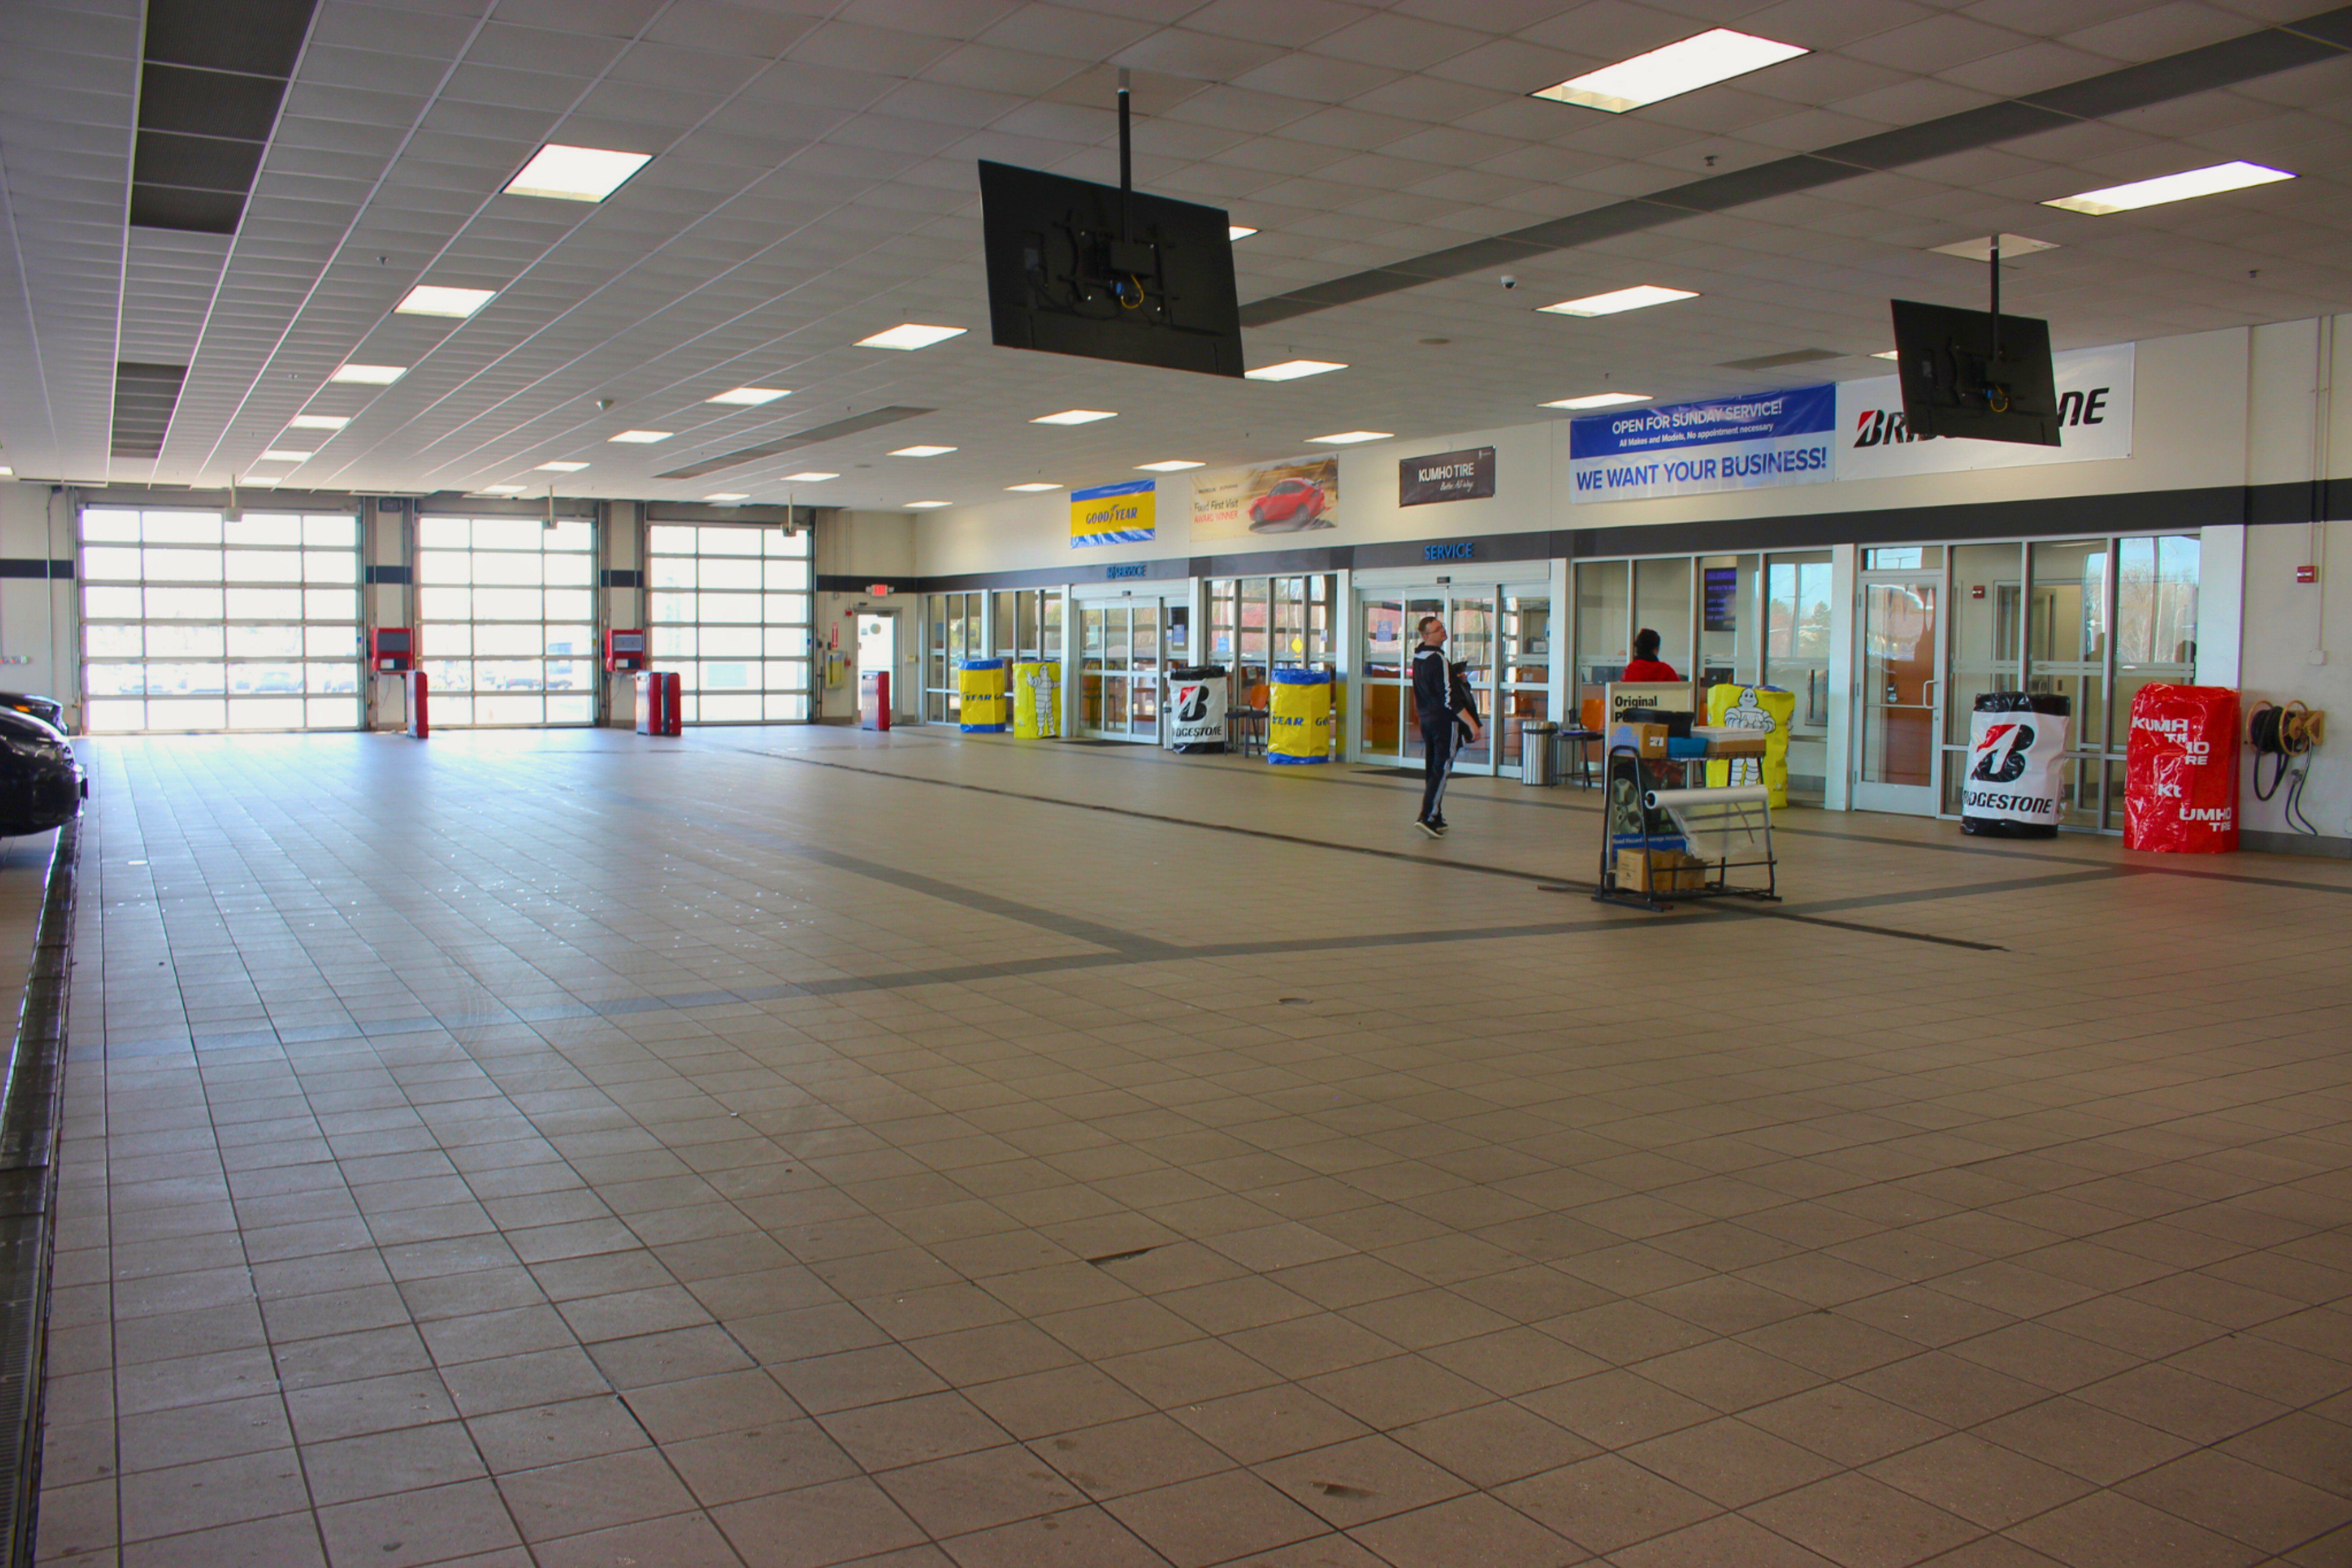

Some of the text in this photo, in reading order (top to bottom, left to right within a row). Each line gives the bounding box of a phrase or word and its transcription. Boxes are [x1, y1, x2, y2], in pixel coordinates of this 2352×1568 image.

[1612, 400, 1782, 435] OPEN FOR SUNDAY SERVICE!
[1619, 439, 1627, 447] All
[1628, 437, 1647, 446] Makes
[1649, 435, 1661, 444] and
[1687, 431, 1696, 439] No
[1697, 426, 1739, 440] appointment
[1740, 423, 1774, 433] necessary
[1418, 462, 1474, 482] KUMHO TIRE
[1576, 446, 1827, 491] WE WANT YOUR BUSINESS!
[1086, 505, 1137, 524] GOODYEAR
[1425, 543, 1472, 560] SERVICE
[1615, 695, 1658, 709] Original
